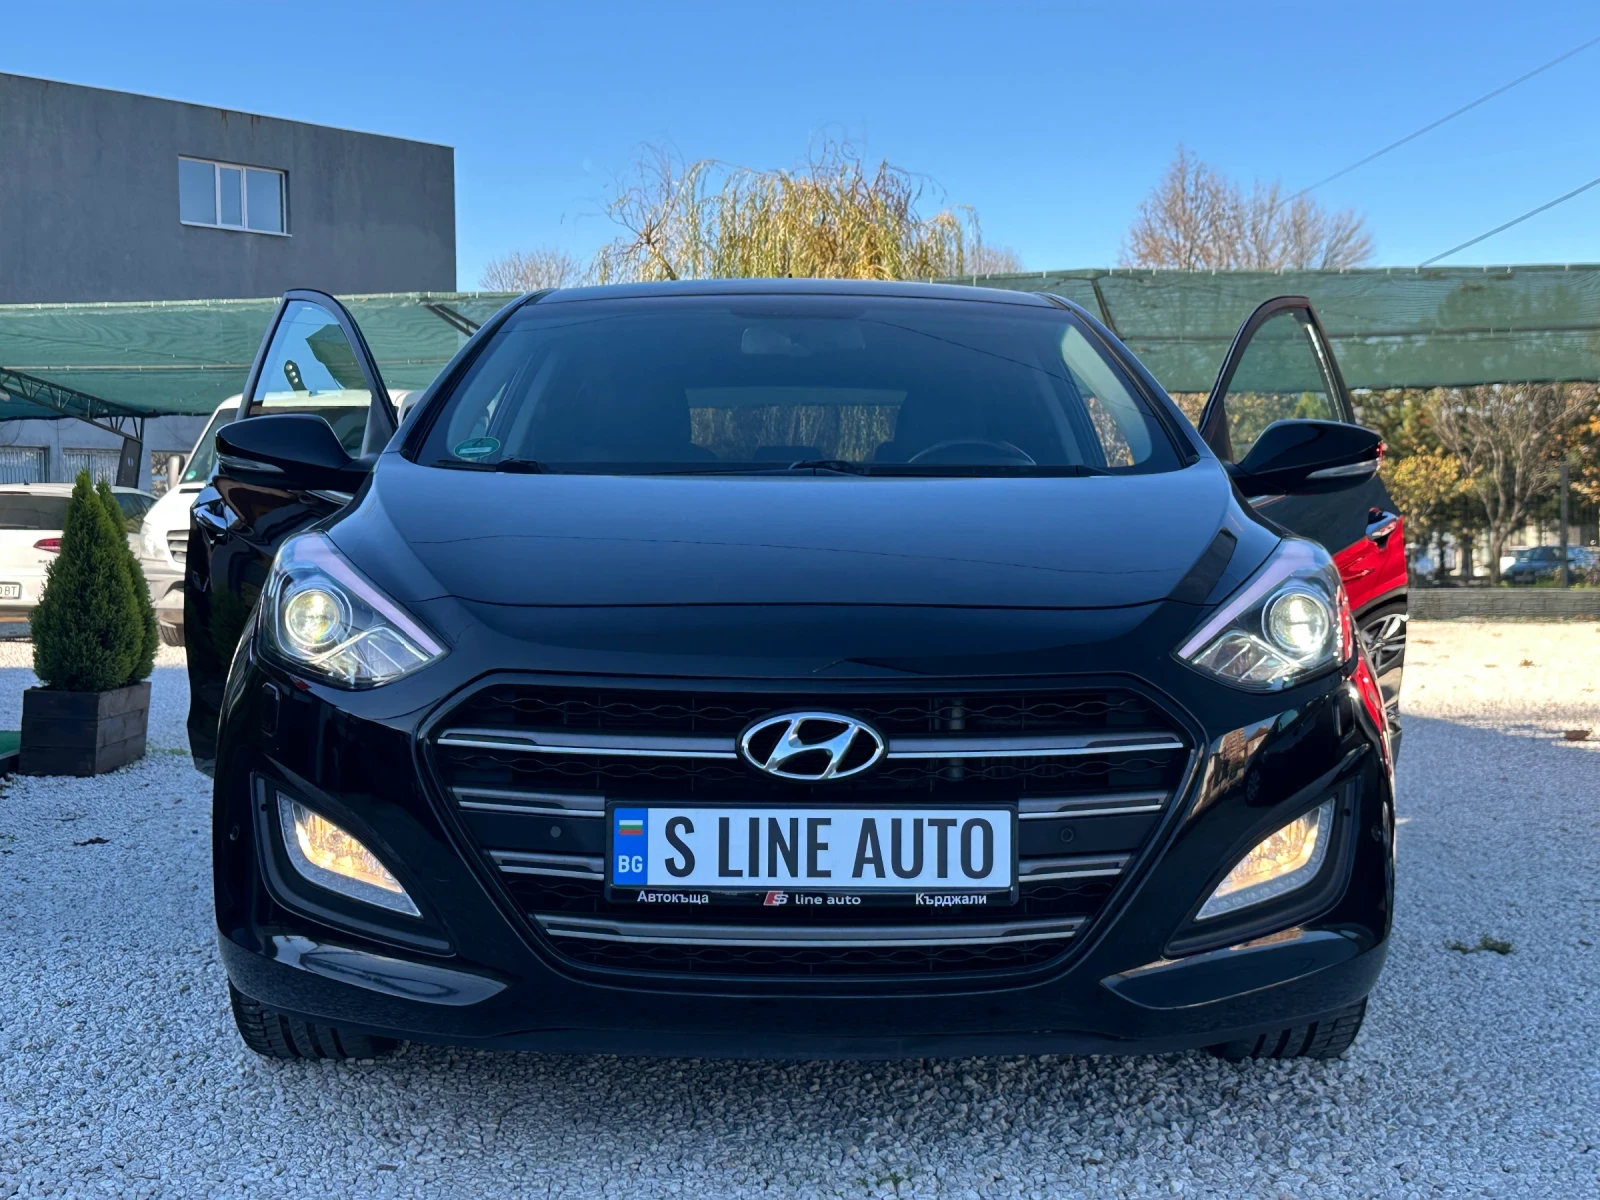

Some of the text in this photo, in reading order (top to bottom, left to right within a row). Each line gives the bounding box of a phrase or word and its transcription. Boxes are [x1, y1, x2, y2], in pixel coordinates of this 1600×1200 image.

[664, 816, 994, 880] S LINE AUTO
[617, 855, 643, 873] BG
[636, 890, 709, 905] Автокъща
[795, 893, 824, 905] line
[826, 895, 862, 905] auto
[915, 892, 987, 907] Кърджали
